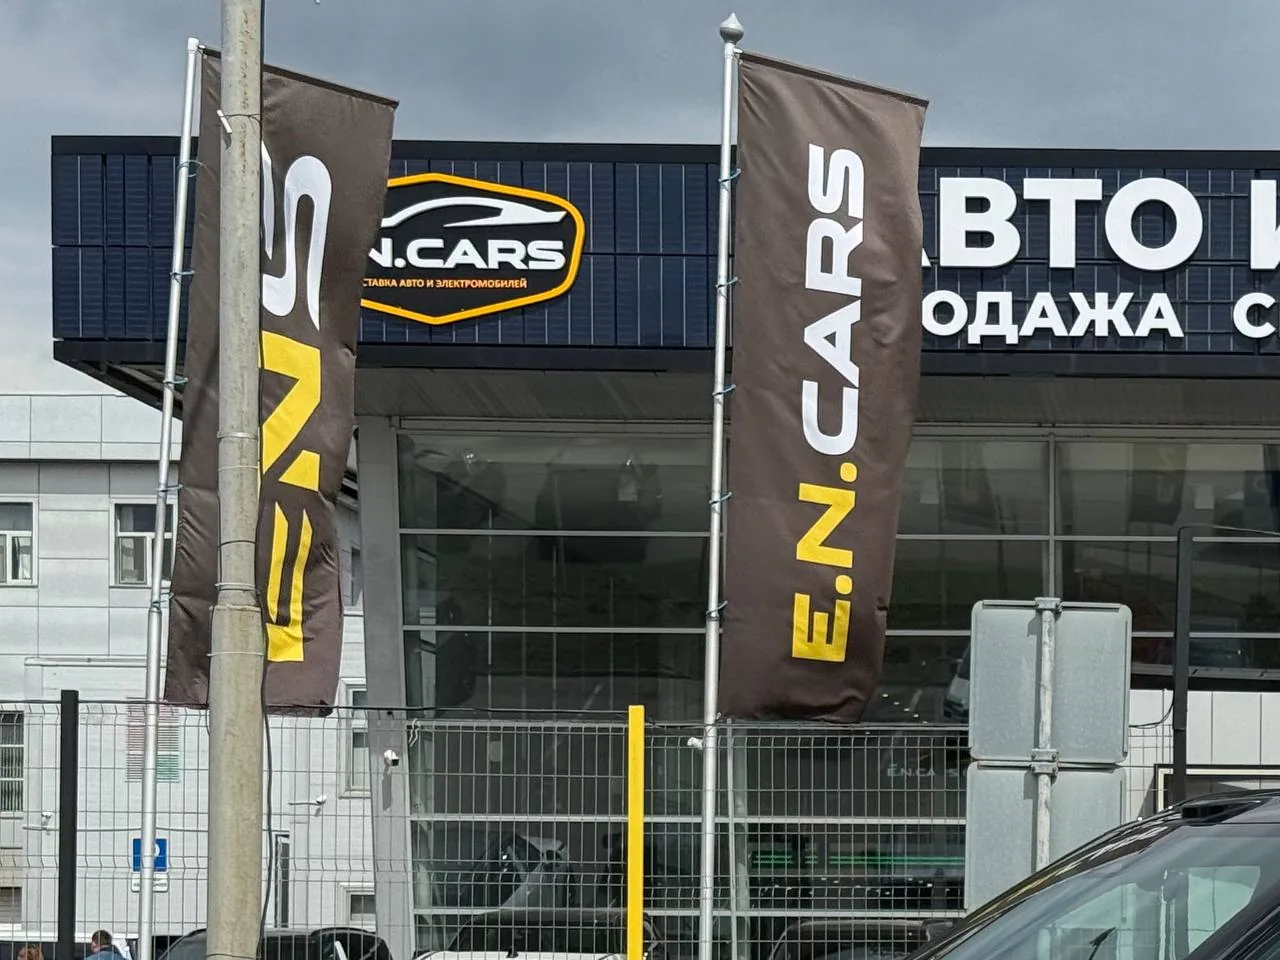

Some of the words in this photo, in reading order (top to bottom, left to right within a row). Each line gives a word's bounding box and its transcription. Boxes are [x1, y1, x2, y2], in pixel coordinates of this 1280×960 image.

[921, 176, 1203, 272] ВТО
[399, 279, 425, 288] АВТО
[426, 279, 434, 288] И
[435, 278, 528, 289] ЭЛЕКТРОМОБИЛЕЙ
[792, 143, 865, 663] E.N.CARS
